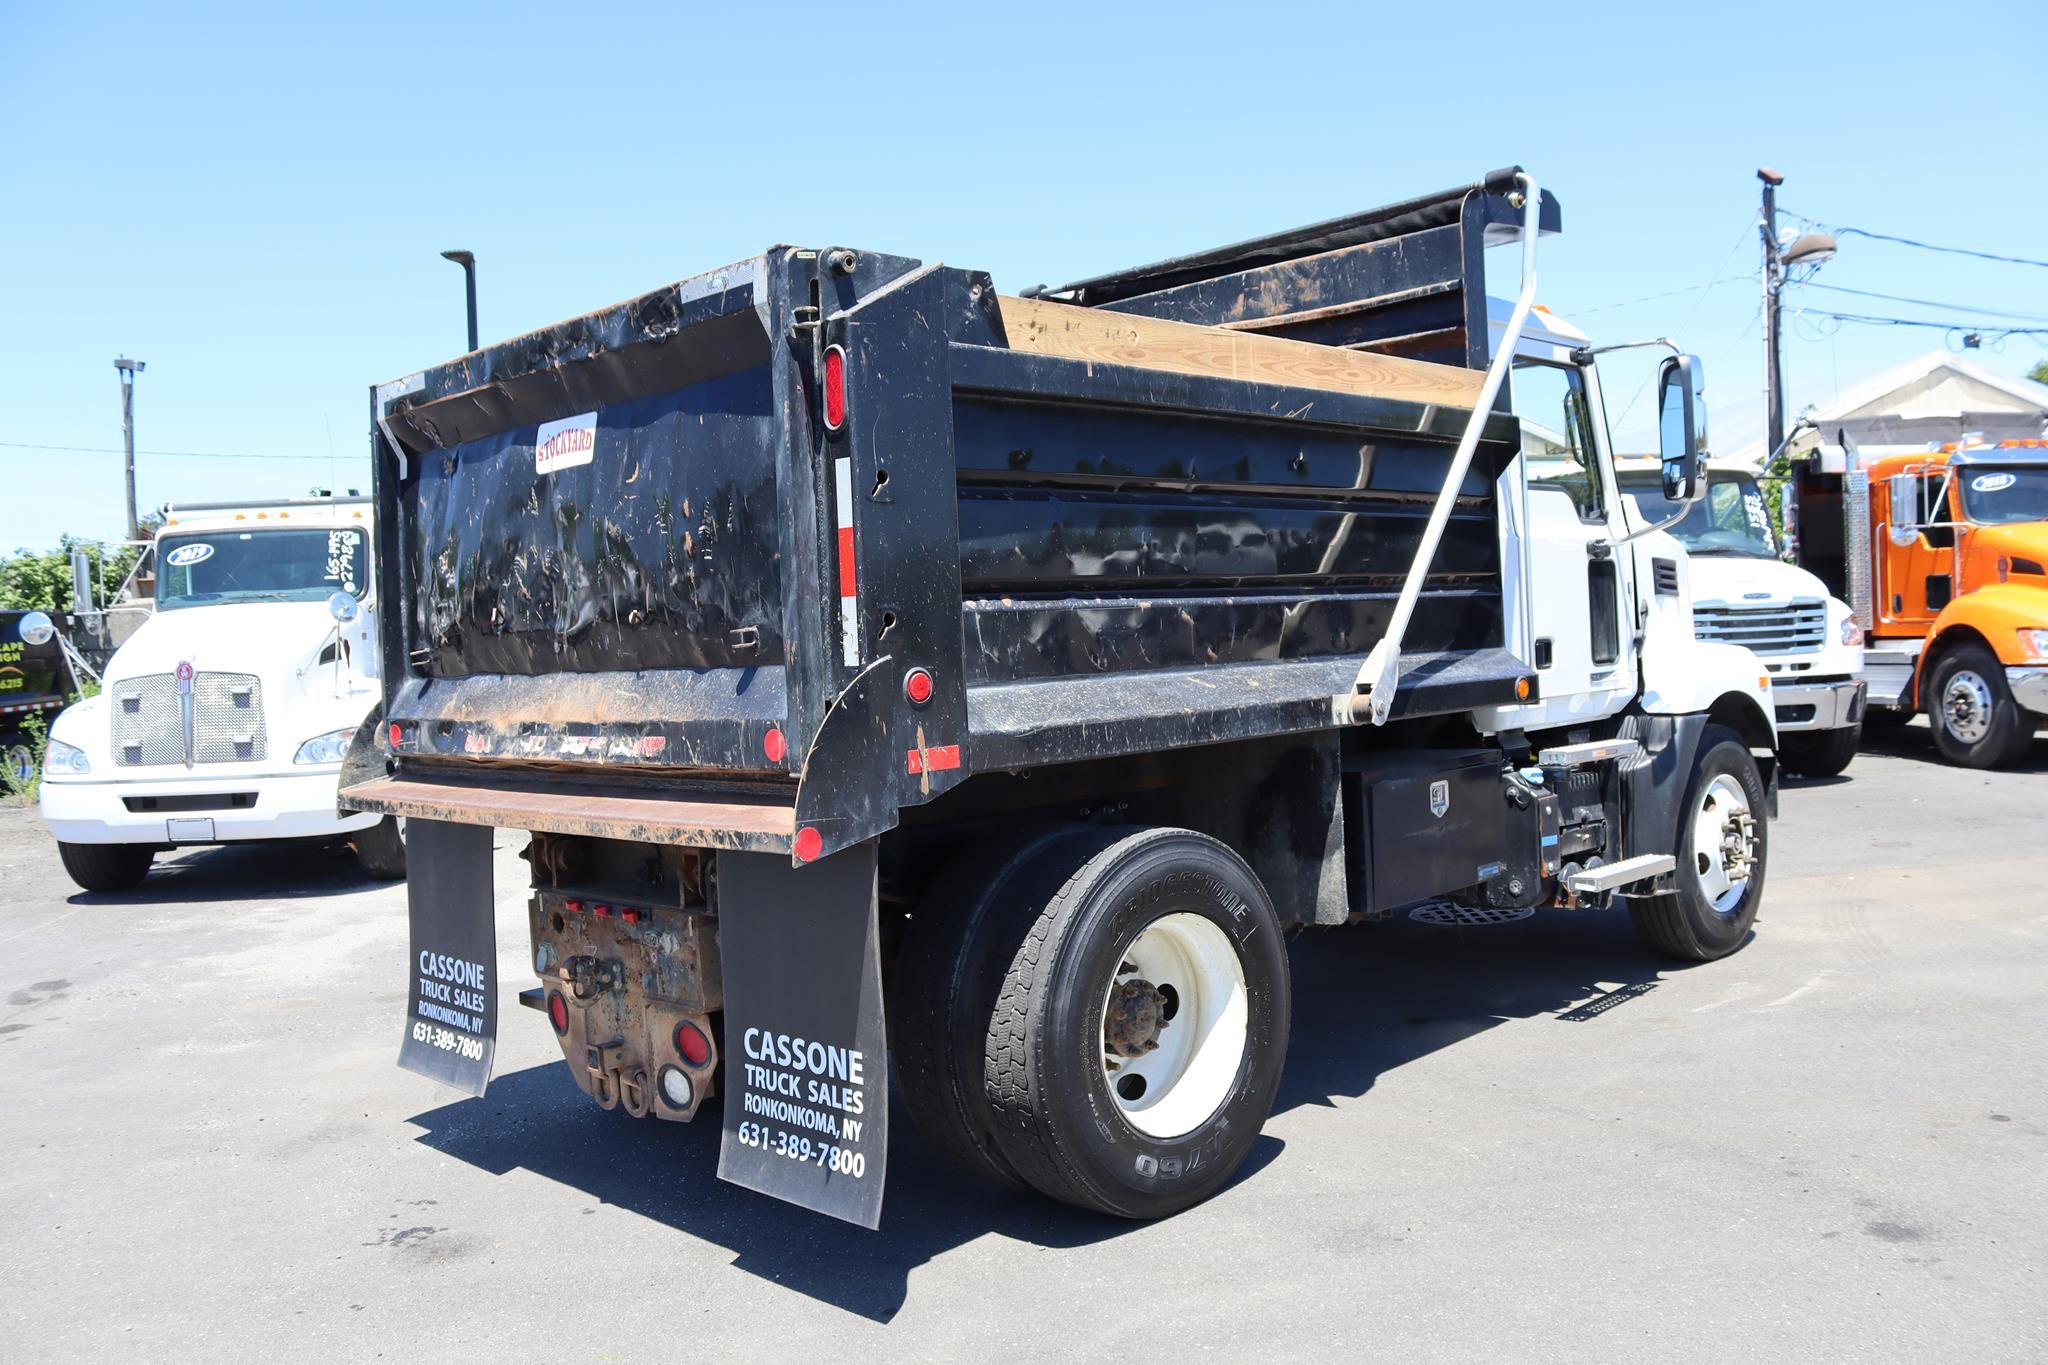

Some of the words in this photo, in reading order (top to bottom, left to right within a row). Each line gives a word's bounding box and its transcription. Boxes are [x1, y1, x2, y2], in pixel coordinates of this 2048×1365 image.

[538, 428, 593, 462] STOCKYARD
[0, 642, 25, 651] APE
[419, 950, 485, 991] CASSONE
[419, 978, 451, 1003] TRUCK
[453, 988, 485, 1013] SALES
[418, 1000, 471, 1033] RONKONKOMA,
[471, 1017, 484, 1034] NY
[412, 1021, 484, 1061] 631-389-7800
[743, 1027, 865, 1086] CASSONE
[744, 1063, 801, 1099] TRUCK
[807, 1079, 864, 1115] SALES
[744, 1092, 841, 1140] RONKONKOMA,
[842, 1117, 863, 1143] NY
[738, 1121, 866, 1179] 631-389-7800
